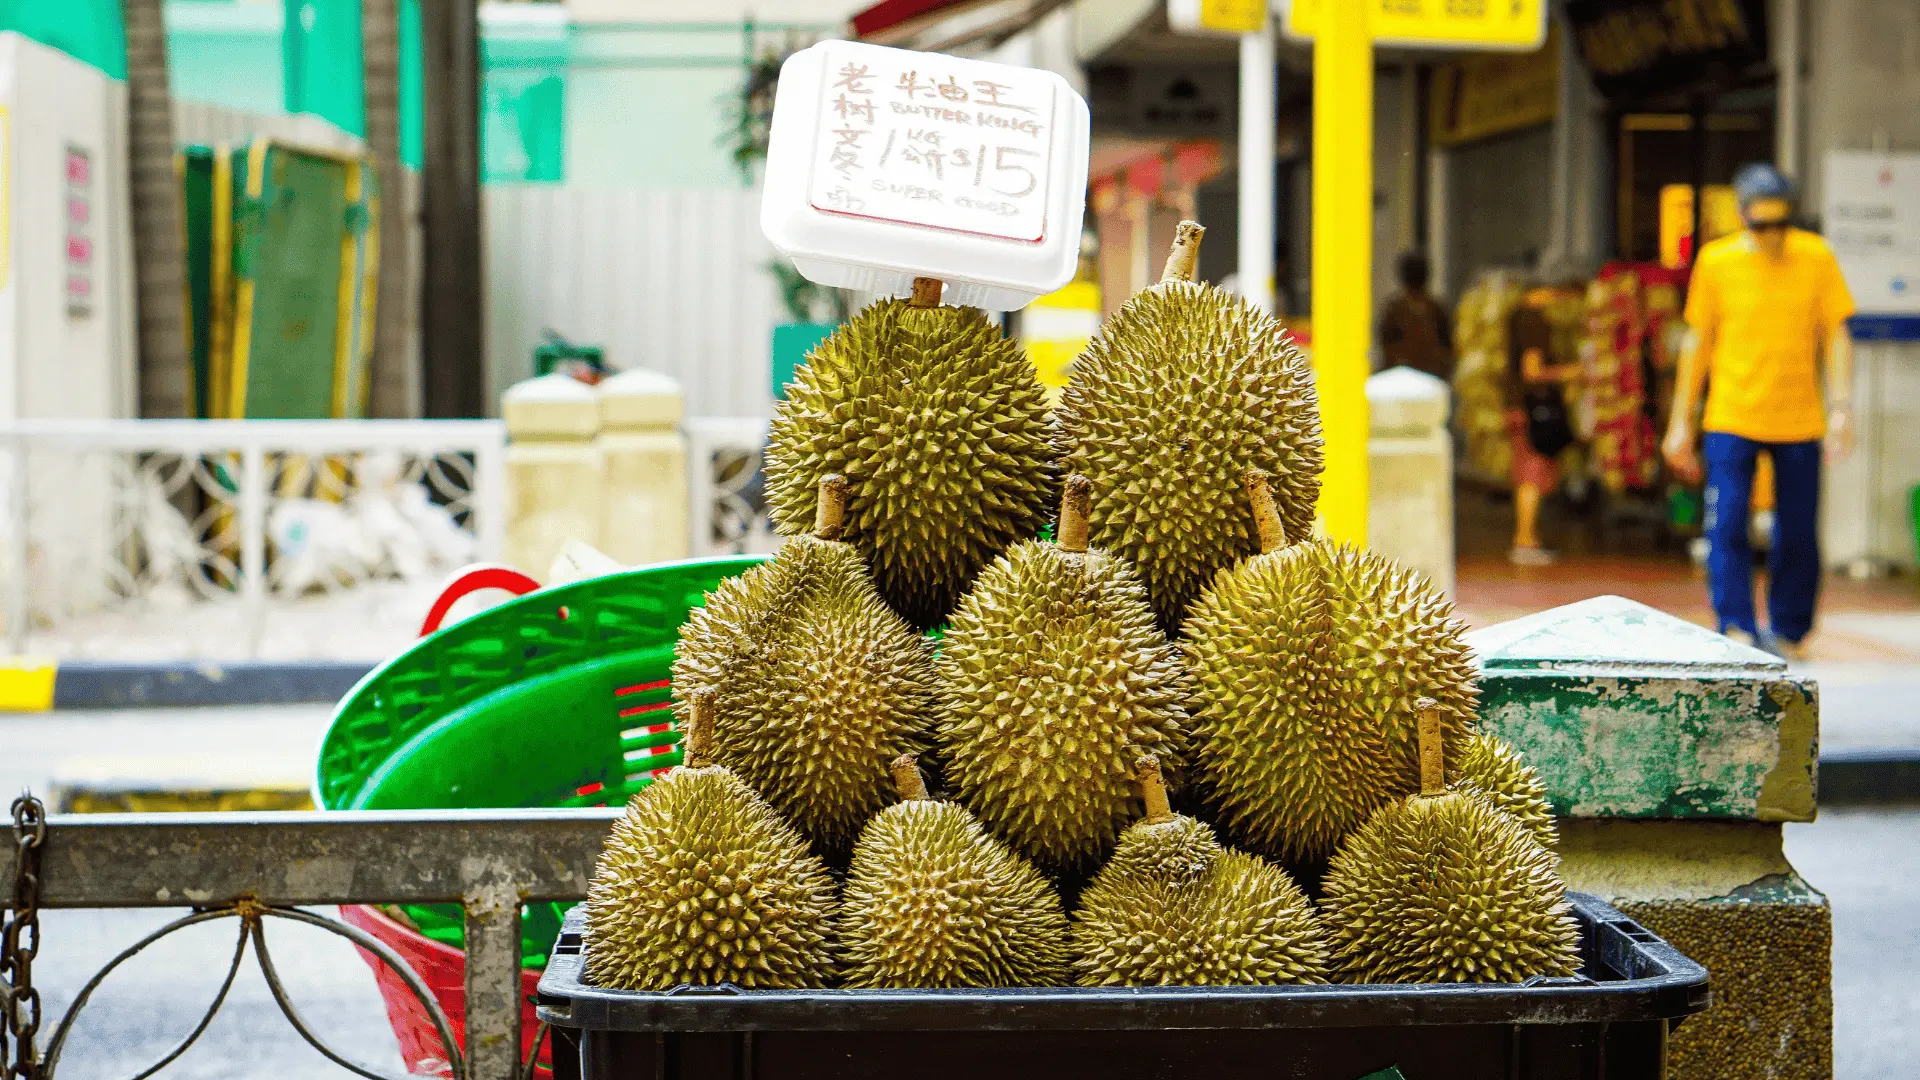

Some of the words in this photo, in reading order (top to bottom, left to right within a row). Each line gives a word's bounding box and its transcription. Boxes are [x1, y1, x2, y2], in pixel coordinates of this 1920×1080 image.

[895, 71, 1037, 114] 牛油王
[891, 103, 972, 125] BUTTER
[979, 112, 1044, 137] KING
[872, 181, 944, 203] SUPER
[955, 198, 1019, 216] GOOD
